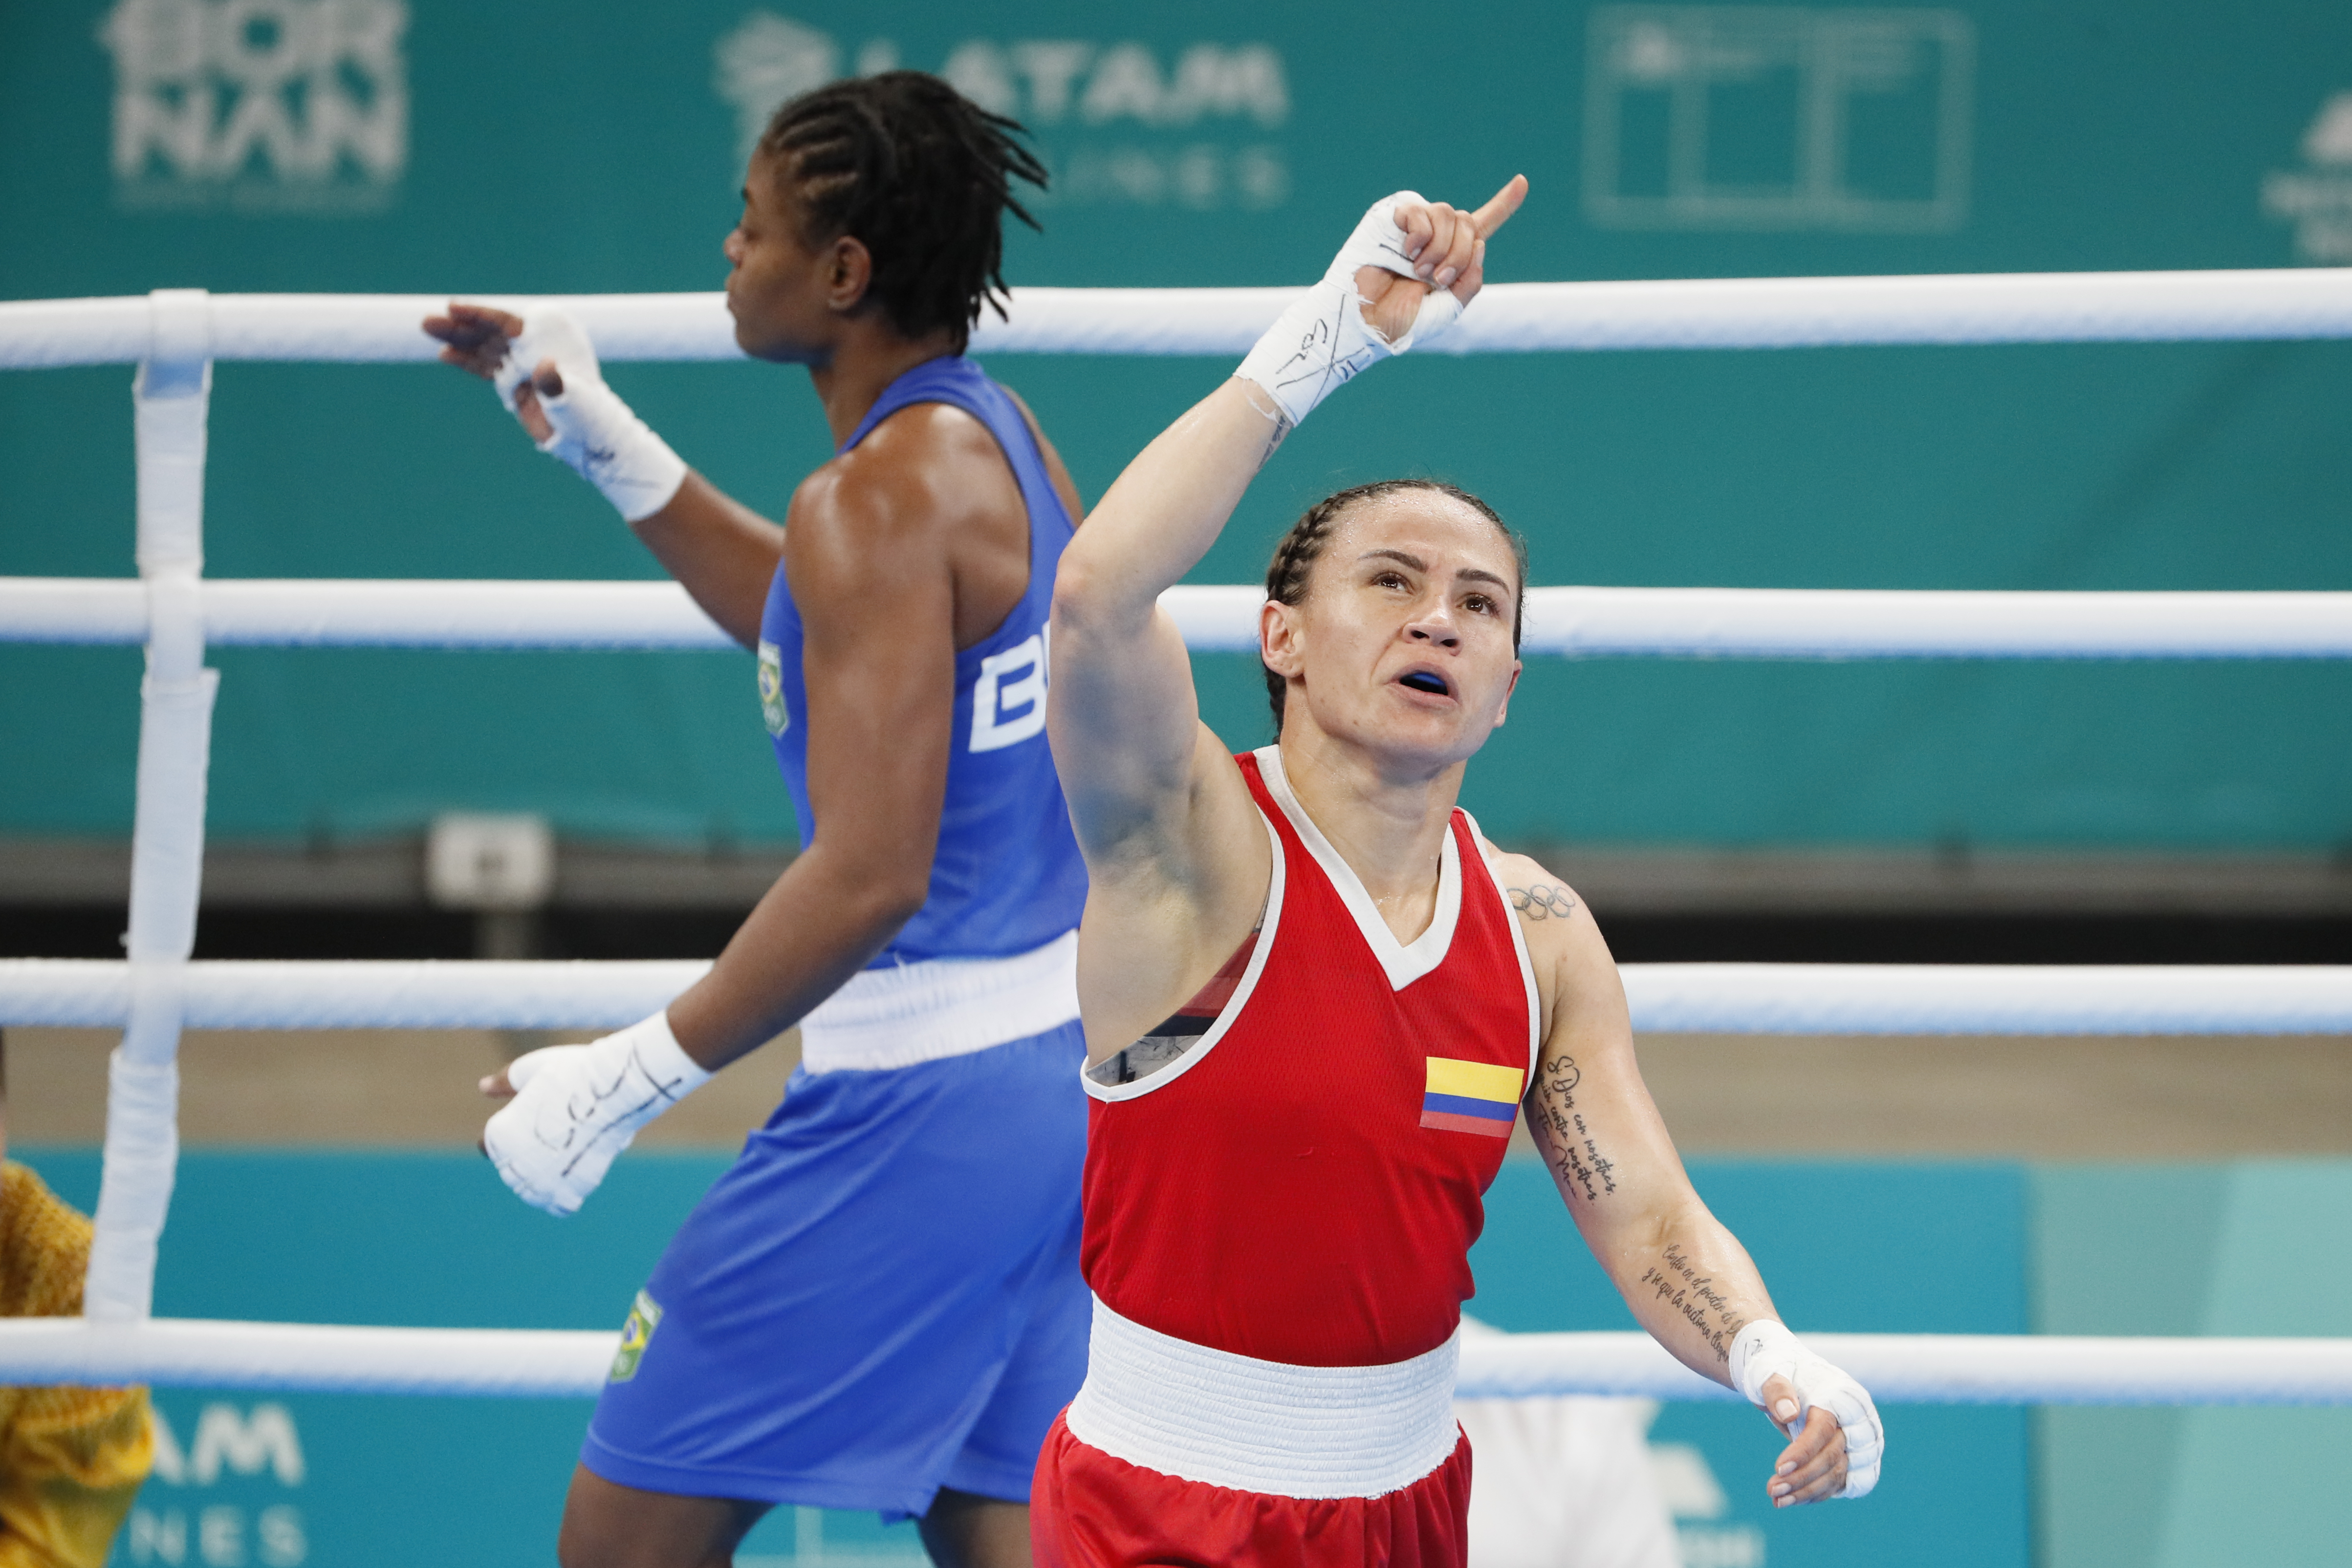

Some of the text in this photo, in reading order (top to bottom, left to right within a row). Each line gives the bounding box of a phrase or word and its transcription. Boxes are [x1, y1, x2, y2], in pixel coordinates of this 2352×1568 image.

[110, 59, 408, 180] NAN
[968, 620, 1050, 753] B
[1550, 1106, 1568, 1142] contra
[1552, 1067, 1580, 1109] Dios
[1573, 1114, 1587, 1135] con
[1655, 1282, 1675, 1300] que
[1672, 1289, 1686, 1309] la
[1682, 1303, 1711, 1340] victoria
[1693, 1286, 1727, 1312] poder
